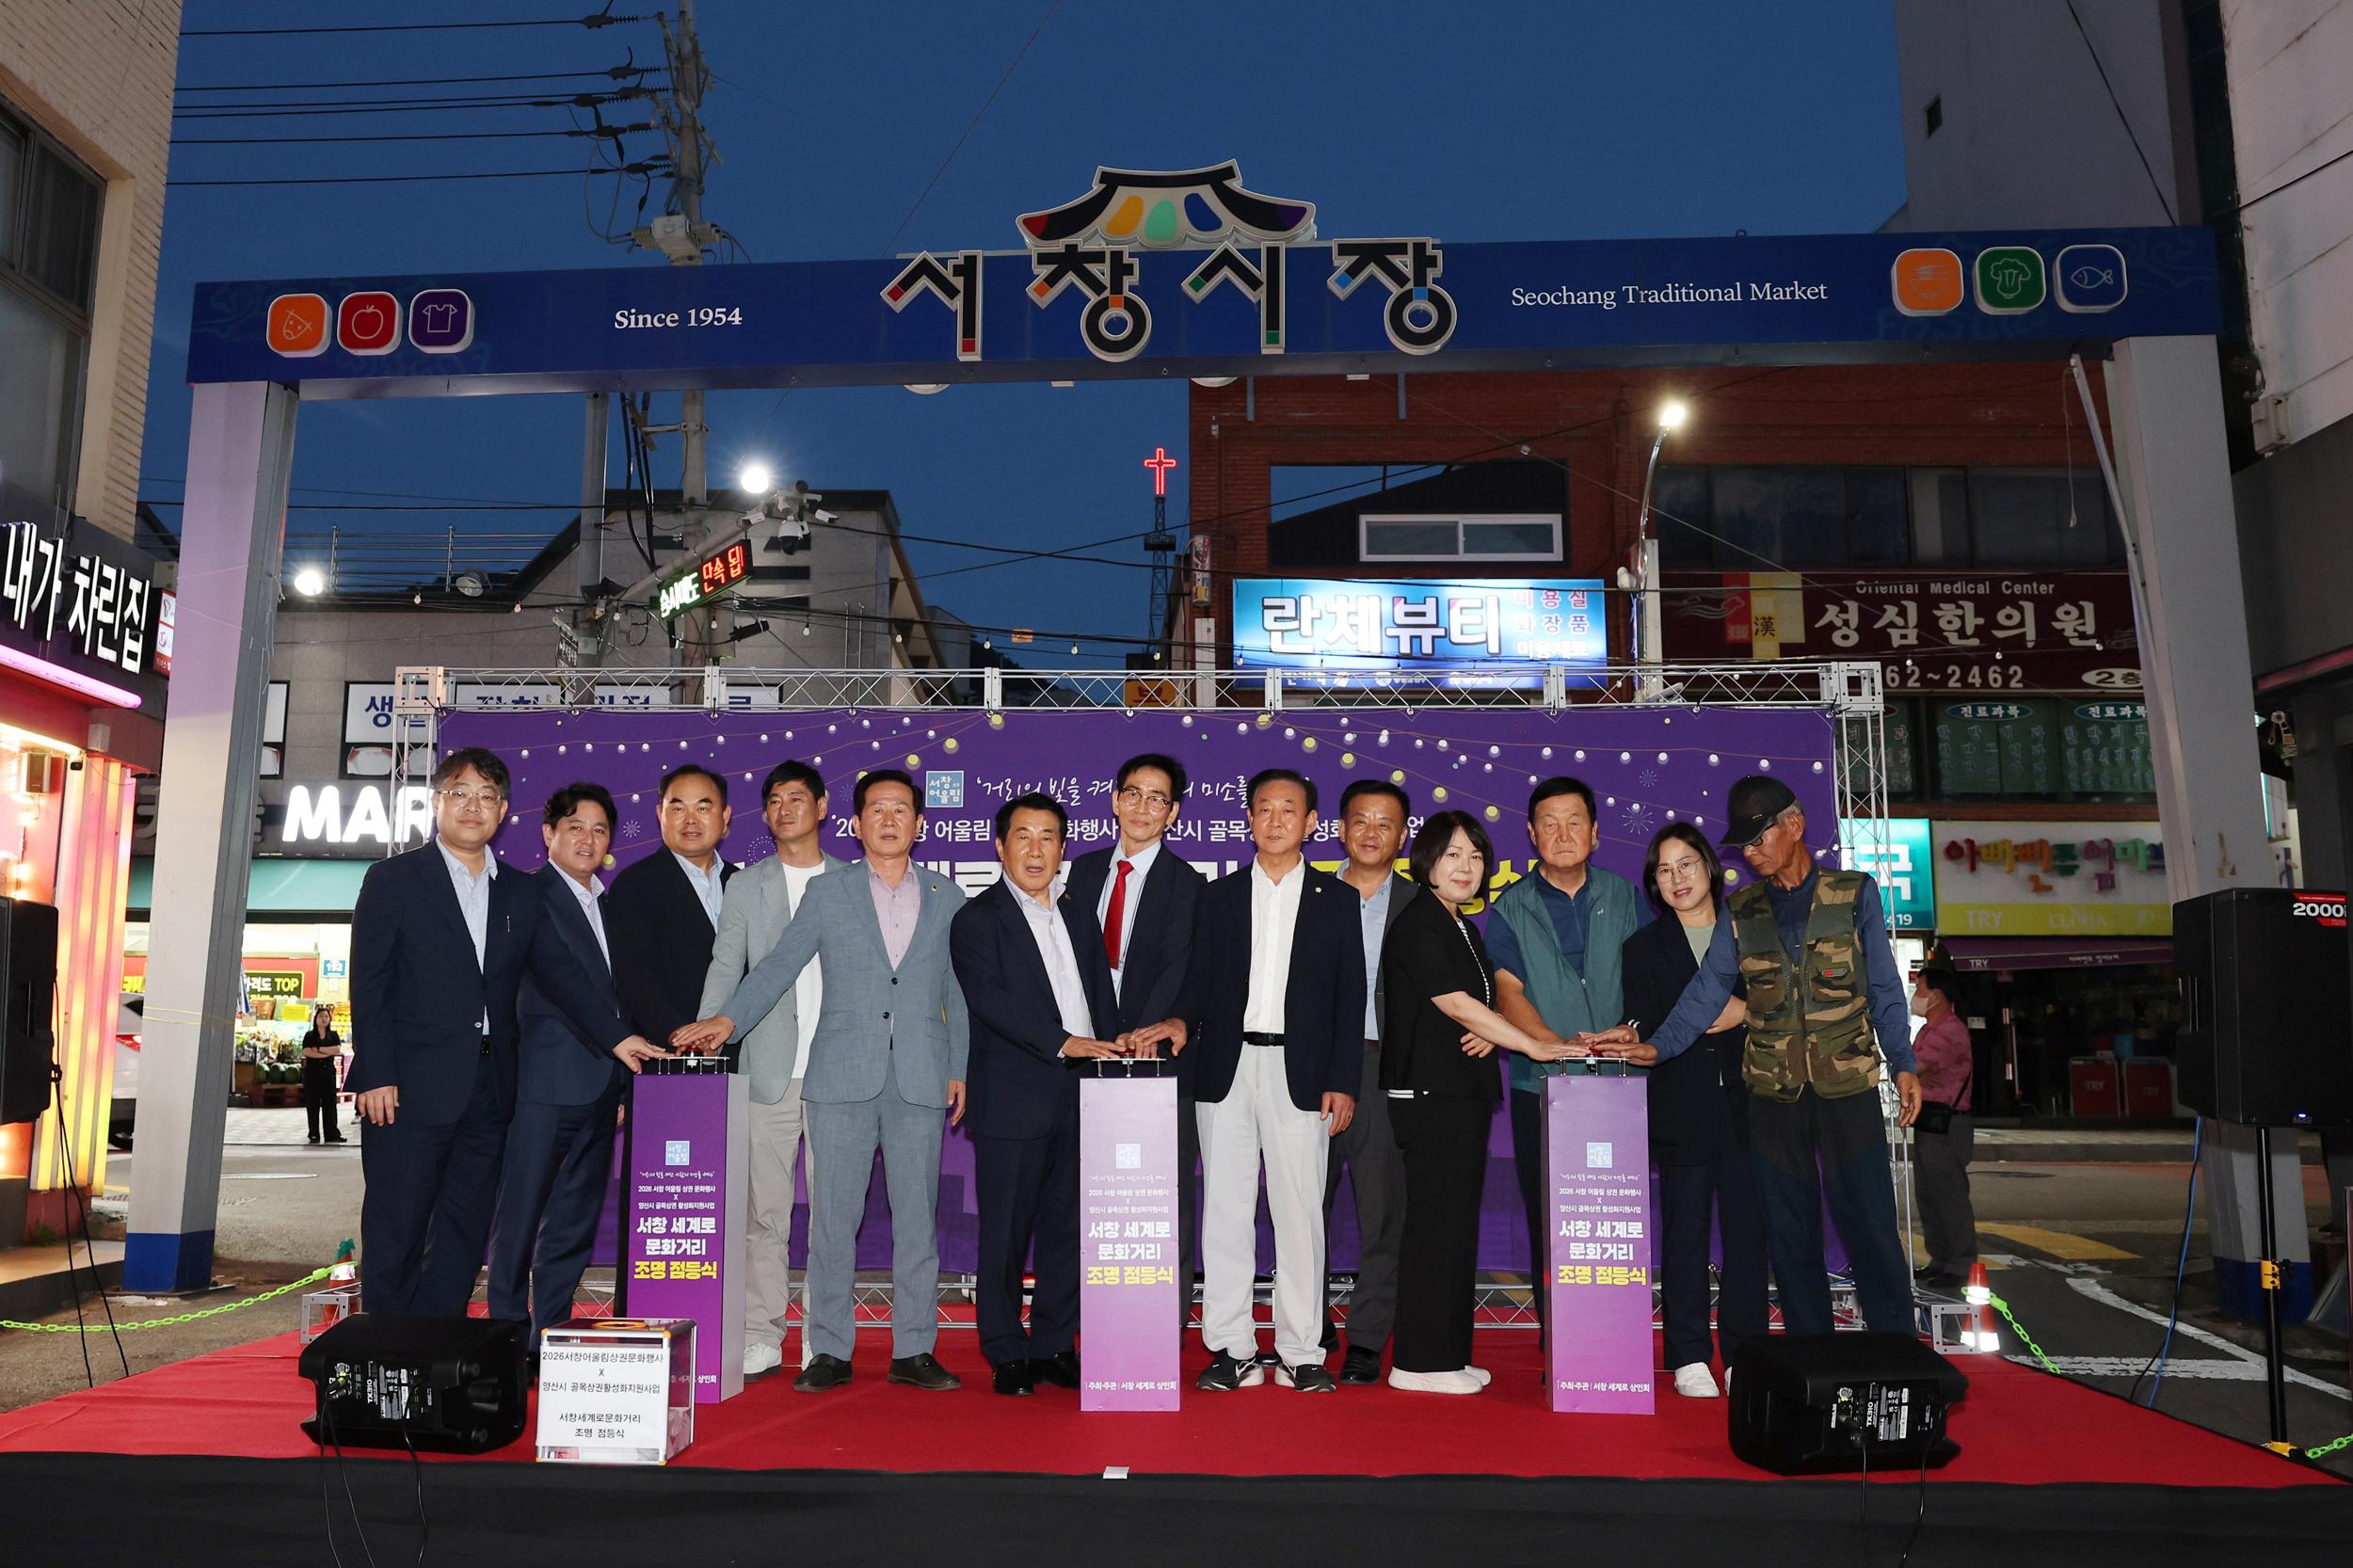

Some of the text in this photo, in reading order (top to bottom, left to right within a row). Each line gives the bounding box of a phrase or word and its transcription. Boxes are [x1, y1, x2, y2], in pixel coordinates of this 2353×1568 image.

[880, 237, 1458, 362] 서창시장
[1512, 280, 1828, 310] Seochang Traditional Market
[614, 307, 744, 329] Since 1954
[728, 546, 744, 578] 됩
[1855, 579, 2056, 595] Oriental Medical Center
[3, 521, 151, 675] 내가 차린집
[1514, 588, 1588, 609] 미용실
[1261, 596, 1503, 655] 란체뷰티
[1514, 615, 1588, 635] 화장품
[1814, 600, 2098, 648] 성심한의원
[1885, 664, 2025, 689] 62~2462
[282, 785, 438, 843] MAR
[935, 819, 991, 841] 어울림
[1065, 819, 1118, 841] 화행사
[1165, 819, 1202, 841] 산시
[2293, 902, 2344, 918] 2000
[1966, 909, 2004, 930] TRY
[1969, 958, 1989, 969] TRY
[275, 978, 299, 992] TOP
[2085, 1080, 2105, 1092] TRY
[2141, 1086, 2160, 1097] TRY
[636, 1216, 716, 1234] 서창 세계로
[1088, 1221, 1171, 1239] 서창 세계로
[1559, 1220, 1643, 1239] 서창 세계로
[646, 1239, 706, 1256] 문화거리
[1097, 1243, 1161, 1260] 문화거리
[1569, 1242, 1634, 1260] 문화거리
[633, 1261, 717, 1280] 조명 점등식
[1086, 1266, 1174, 1285] 조명 점등식
[1558, 1265, 1647, 1286] 조명 점등식
[542, 1351, 664, 1364] 2026서창어울림상권문화행사
[599, 1368, 605, 1377] X
[697, 1375, 717, 1384] 상인회
[543, 1382, 661, 1394] 양산시 골목상권활성화지원사업
[559, 1413, 641, 1424] 서창세계로문화거리
[574, 1428, 625, 1439] 조명 점등식
